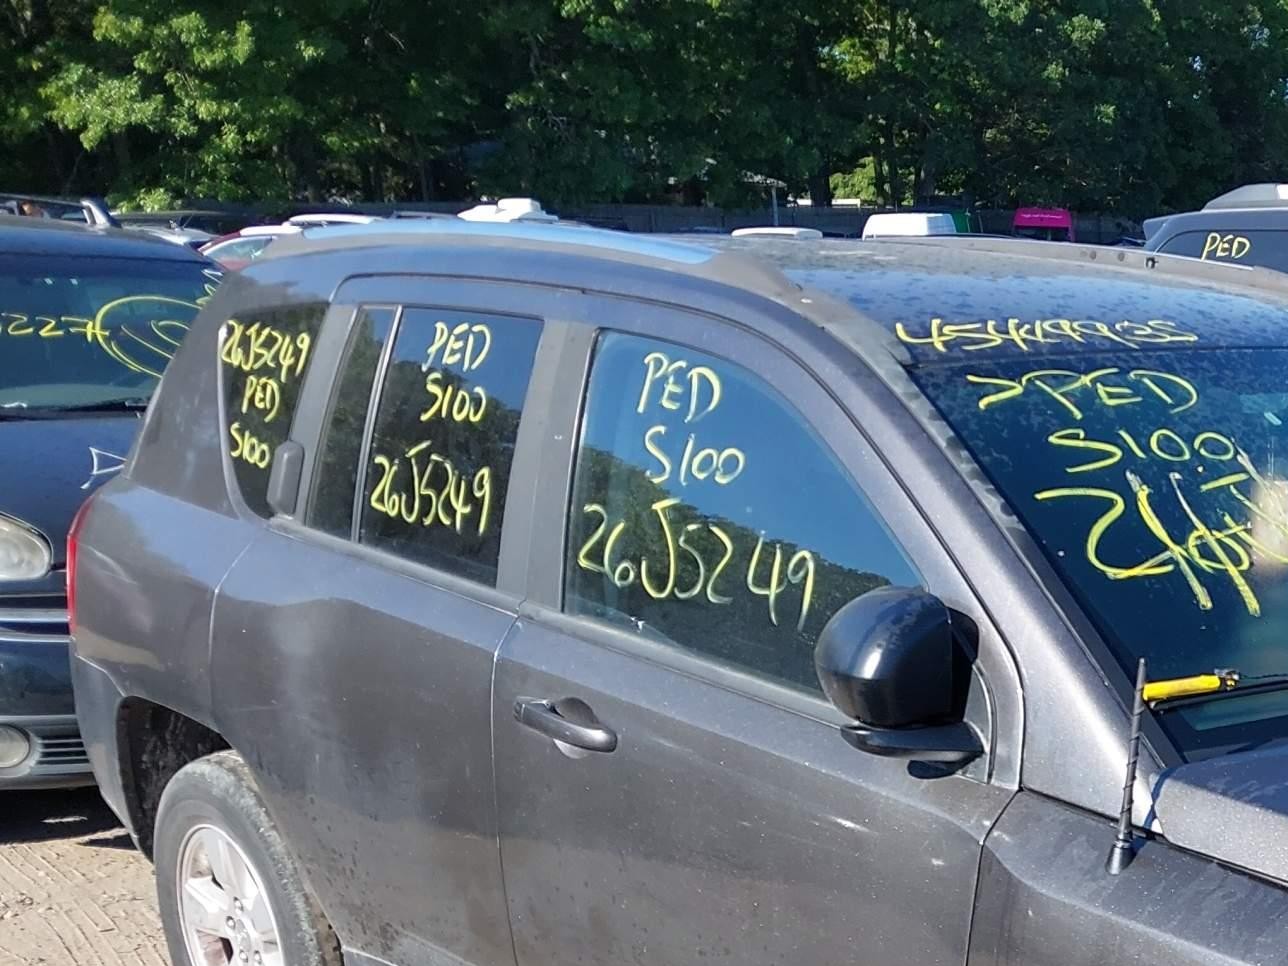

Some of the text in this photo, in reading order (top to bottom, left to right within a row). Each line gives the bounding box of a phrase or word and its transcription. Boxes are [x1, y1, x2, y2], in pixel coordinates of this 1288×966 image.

[1201, 231, 1250, 261] PED
[419, 320, 492, 372] PED
[241, 375, 281, 423] PED
[419, 371, 487, 422] S100
[637, 350, 722, 424] PED
[229, 422, 271, 469] S100
[642, 424, 747, 487] S100
[1047, 427, 1238, 474] S100
[577, 498, 816, 634] 26J5249
